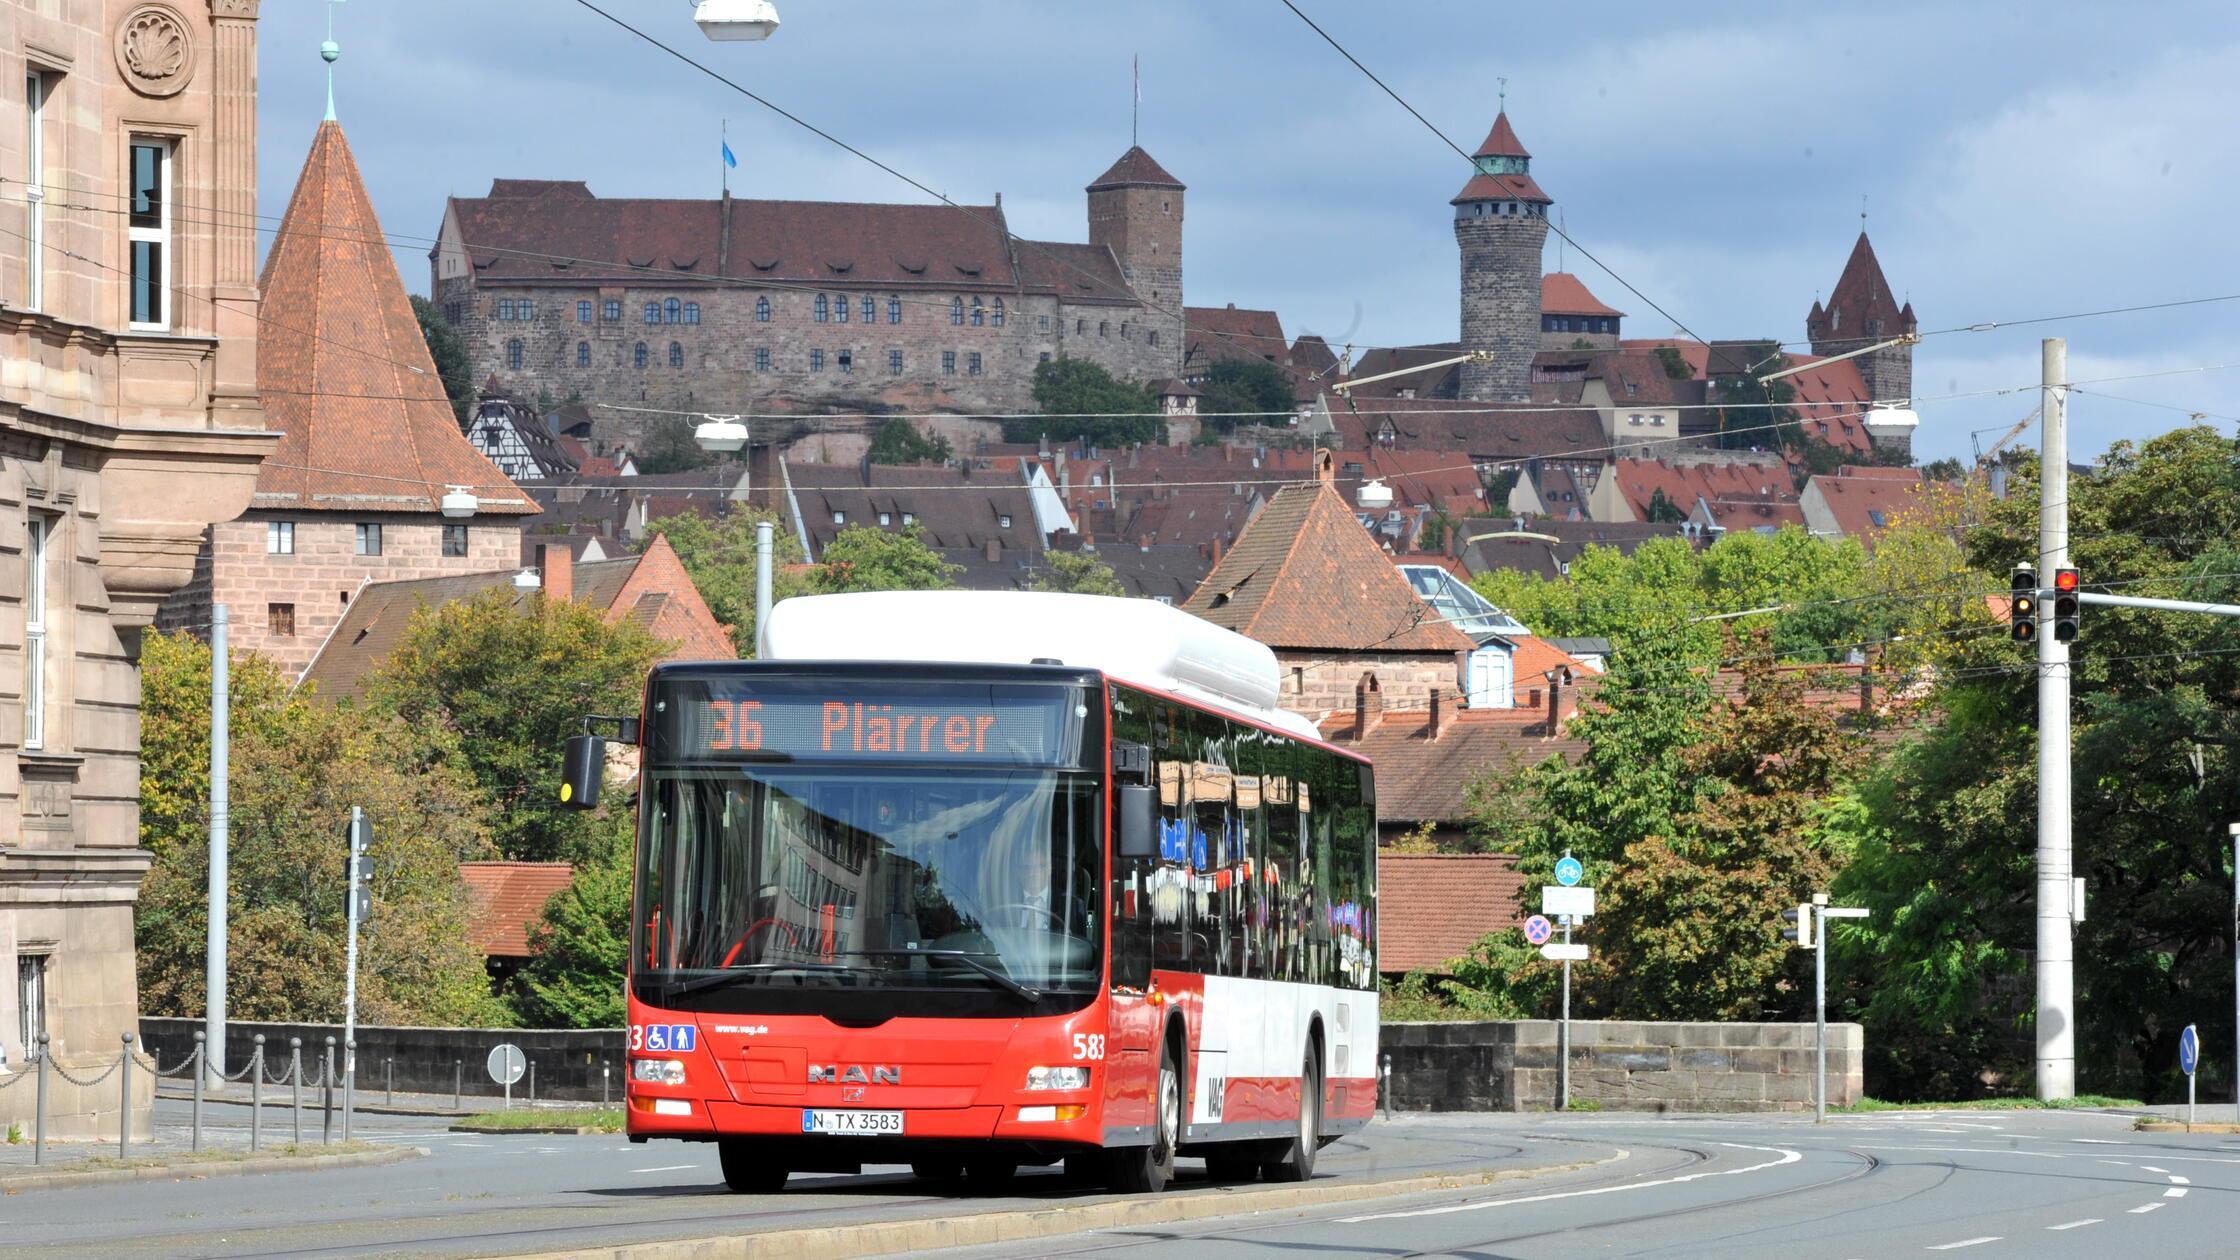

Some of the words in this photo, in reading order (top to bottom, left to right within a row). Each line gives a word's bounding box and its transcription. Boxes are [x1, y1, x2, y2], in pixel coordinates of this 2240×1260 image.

[711, 700, 762, 750] 36
[822, 701, 995, 753] Plärrer
[715, 1025, 769, 1036] www.vag.de
[1072, 1033, 1105, 1060] 583
[808, 1064, 901, 1084] MAN
[1208, 1076, 1223, 1118] VAG
[813, 1113, 824, 1129] N
[835, 1113, 855, 1129] TX
[860, 1114, 899, 1130] 3583
